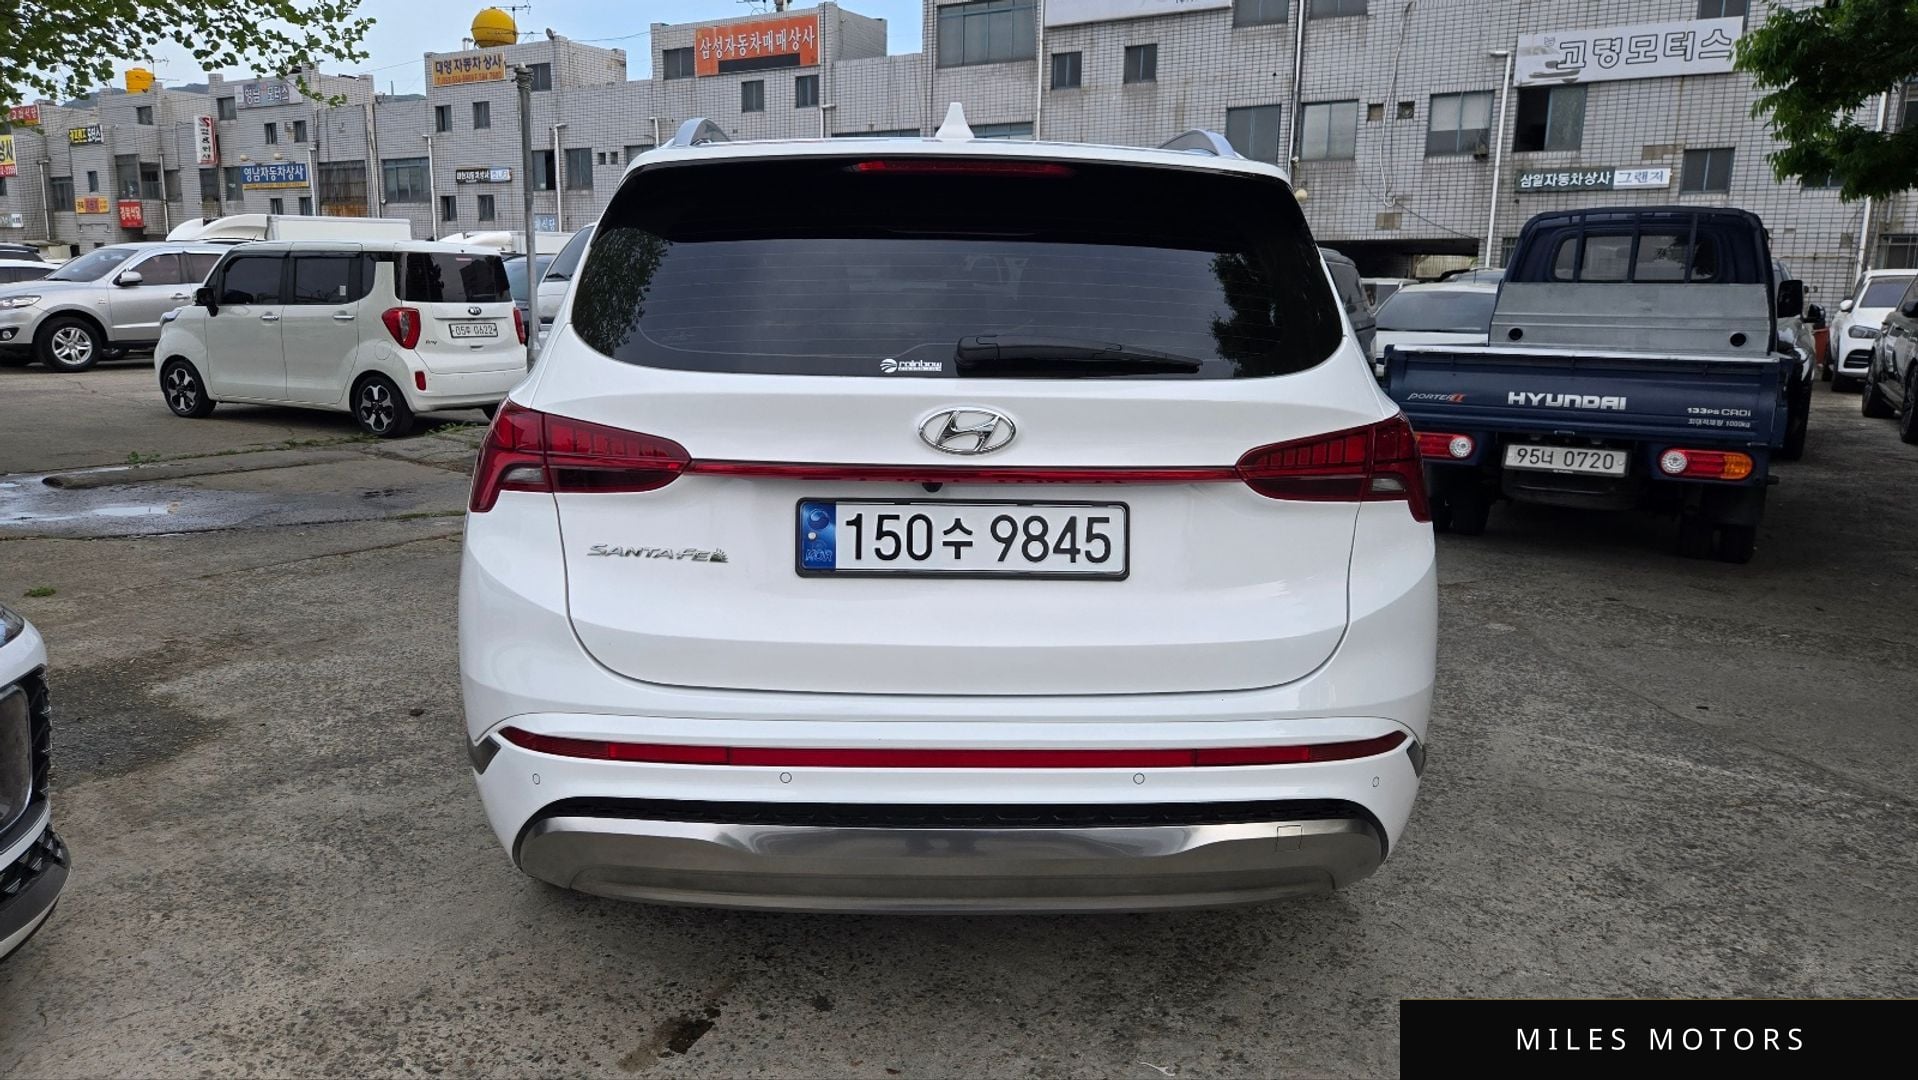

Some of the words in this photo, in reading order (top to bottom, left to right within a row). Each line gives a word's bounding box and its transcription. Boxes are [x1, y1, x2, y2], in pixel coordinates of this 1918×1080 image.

[699, 25, 815, 60] 삼성자동차매매상사
[1556, 29, 1733, 69] 고령모터스
[454, 56, 482, 73] 자동차
[483, 54, 502, 71] 상사
[243, 164, 305, 182] 영남자동차상사
[1520, 171, 1611, 188] 삼일자동차상사
[898, 360, 943, 368] rainbow
[1407, 392, 1454, 401] PORTER
[1507, 391, 1627, 410] HYUNDAI
[1517, 447, 1554, 465] 95너
[1563, 450, 1615, 470] 0720
[845, 512, 974, 561] 150수
[990, 513, 1112, 564] 9845
